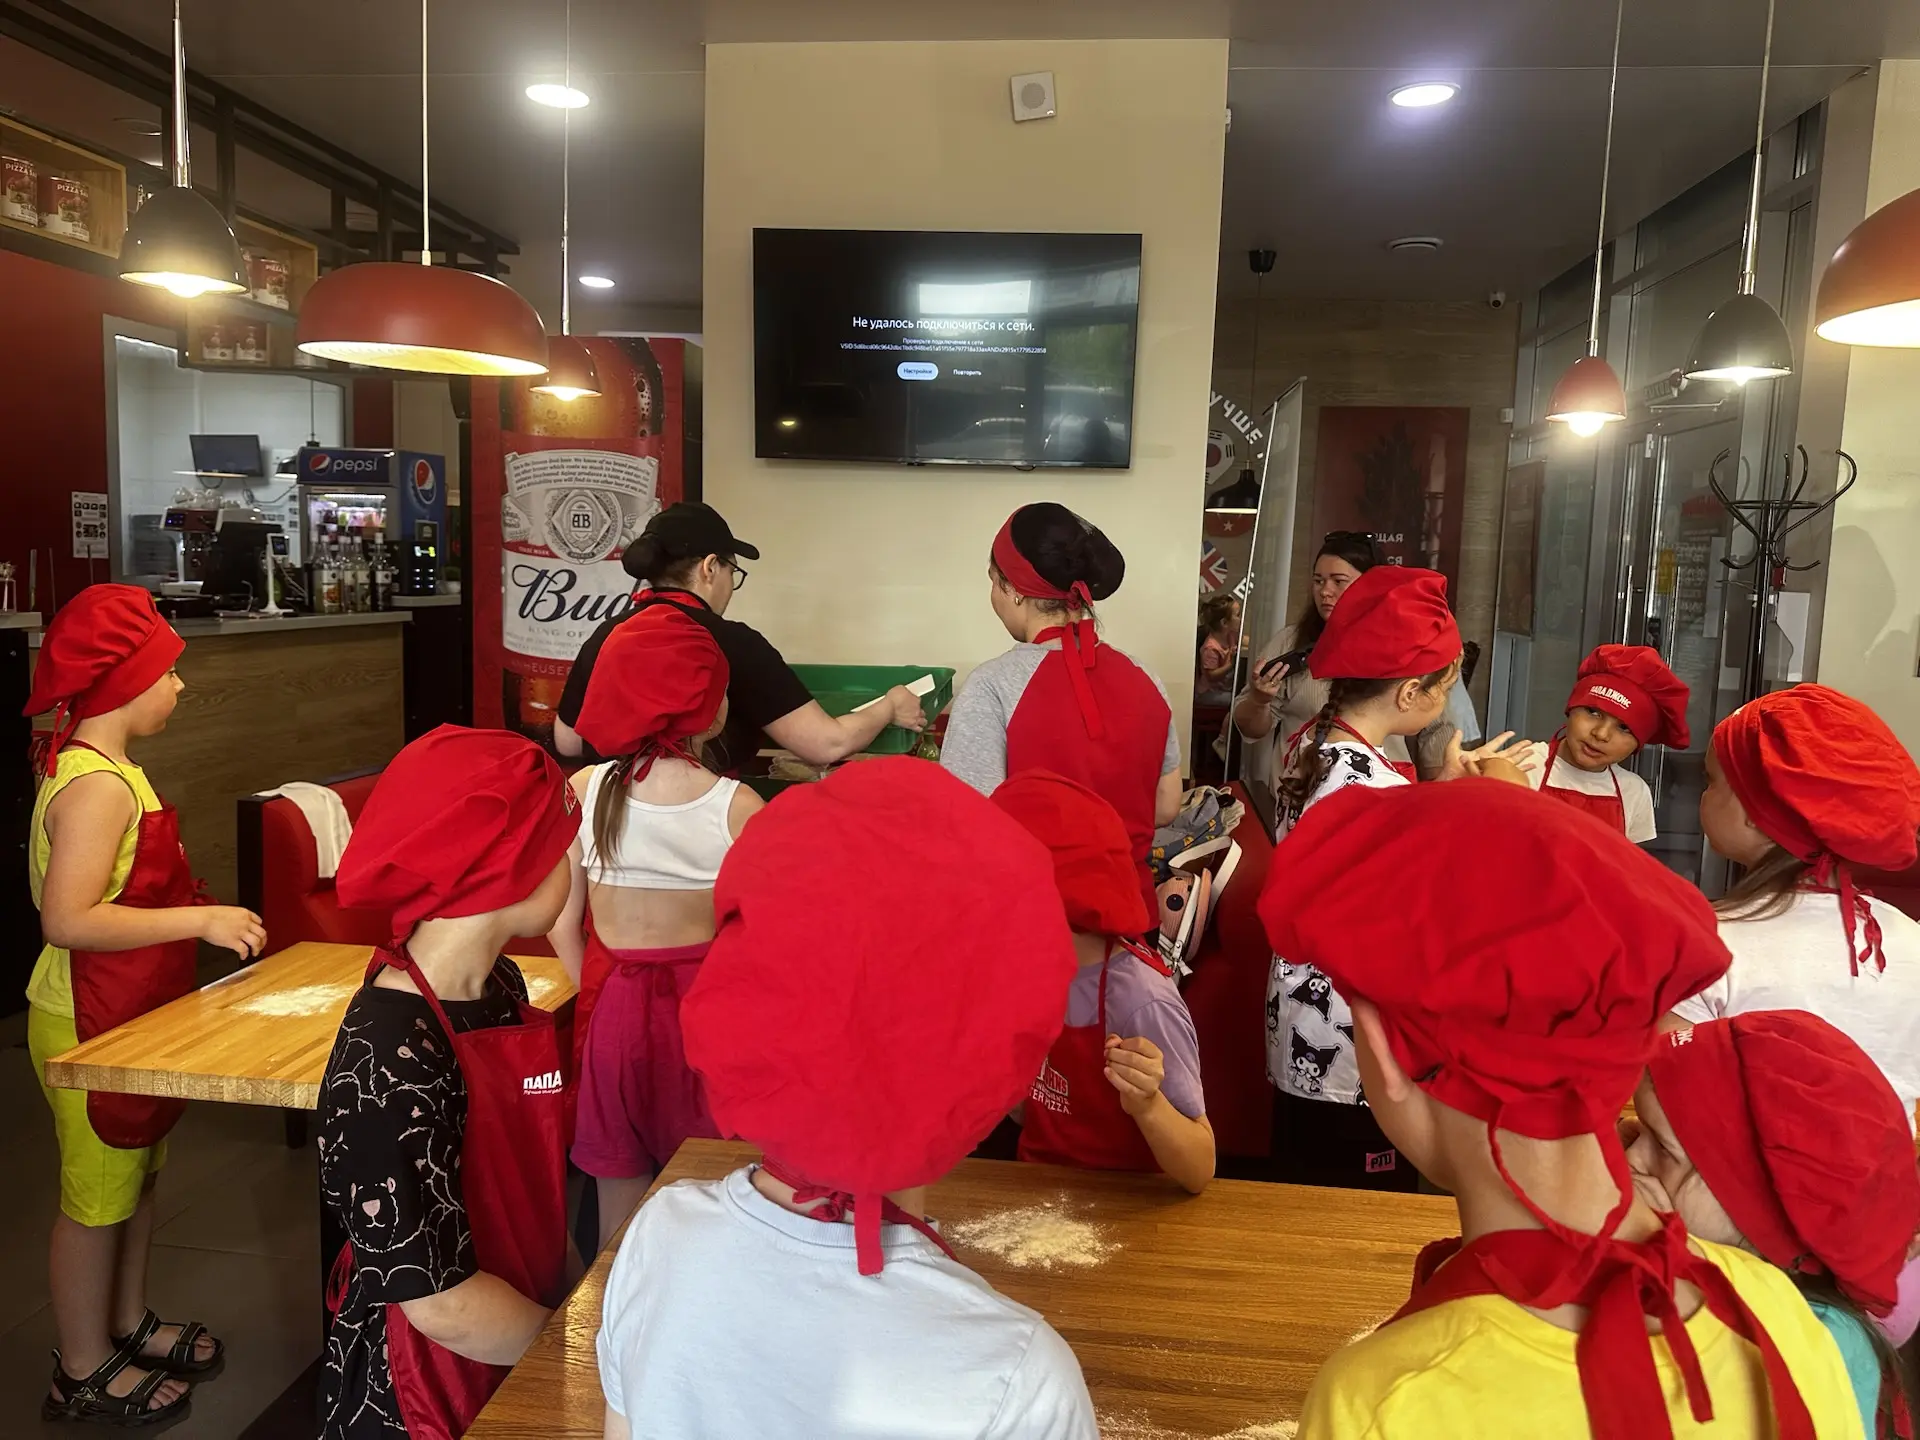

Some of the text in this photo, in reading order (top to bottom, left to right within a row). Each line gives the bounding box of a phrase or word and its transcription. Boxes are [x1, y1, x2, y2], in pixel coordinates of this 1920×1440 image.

[5, 163, 28, 176] PIZZA
[57, 184, 79, 195] PIZZA
[852, 316, 1035, 331] Не удалось подключиться к сети.
[903, 367, 933, 376] Настройки
[953, 368, 982, 376] Повторить
[332, 458, 378, 473] pepsi
[511, 564, 641, 622] Bud
[528, 625, 587, 639] KING OF
[523, 1069, 562, 1090] ПАПА
